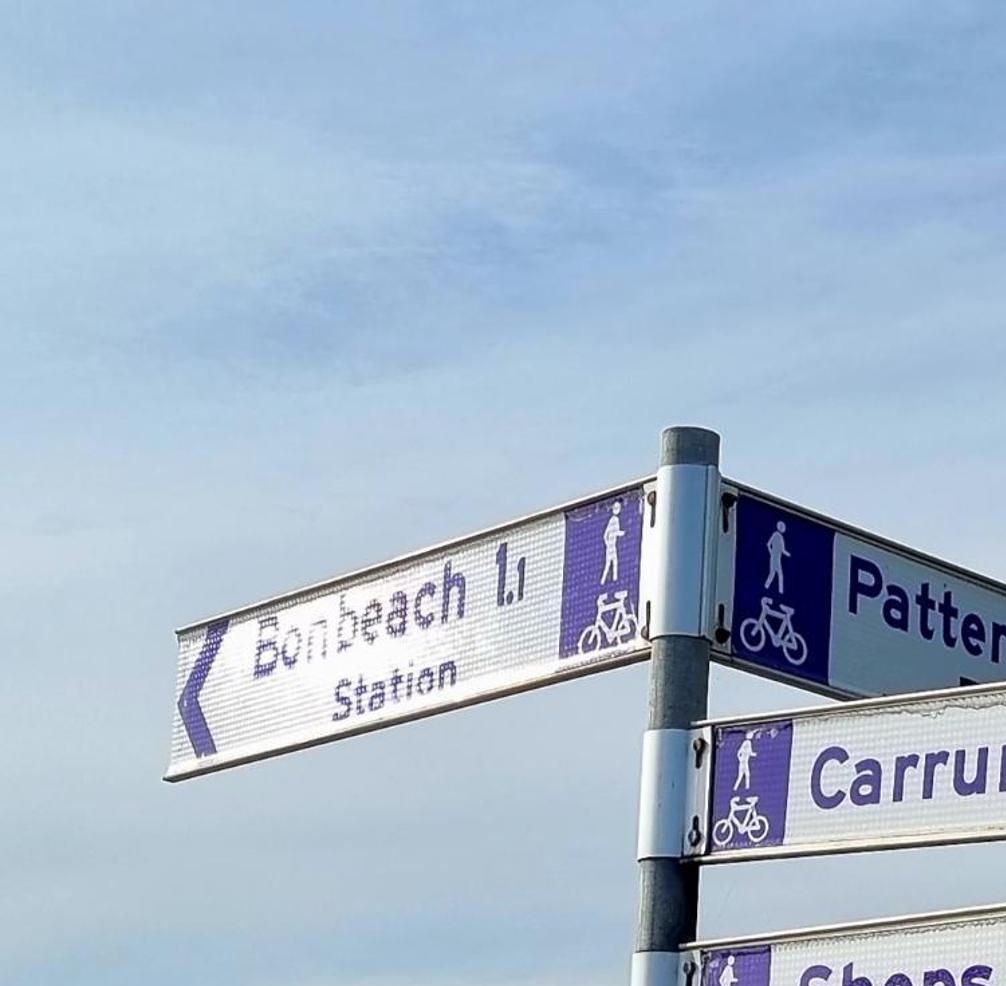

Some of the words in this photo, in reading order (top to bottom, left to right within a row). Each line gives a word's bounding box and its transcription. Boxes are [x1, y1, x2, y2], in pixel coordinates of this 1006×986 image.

[254, 560, 466, 679] Bonbeach
[496, 542, 526, 607] 1.1
[333, 659, 457, 721] Station
